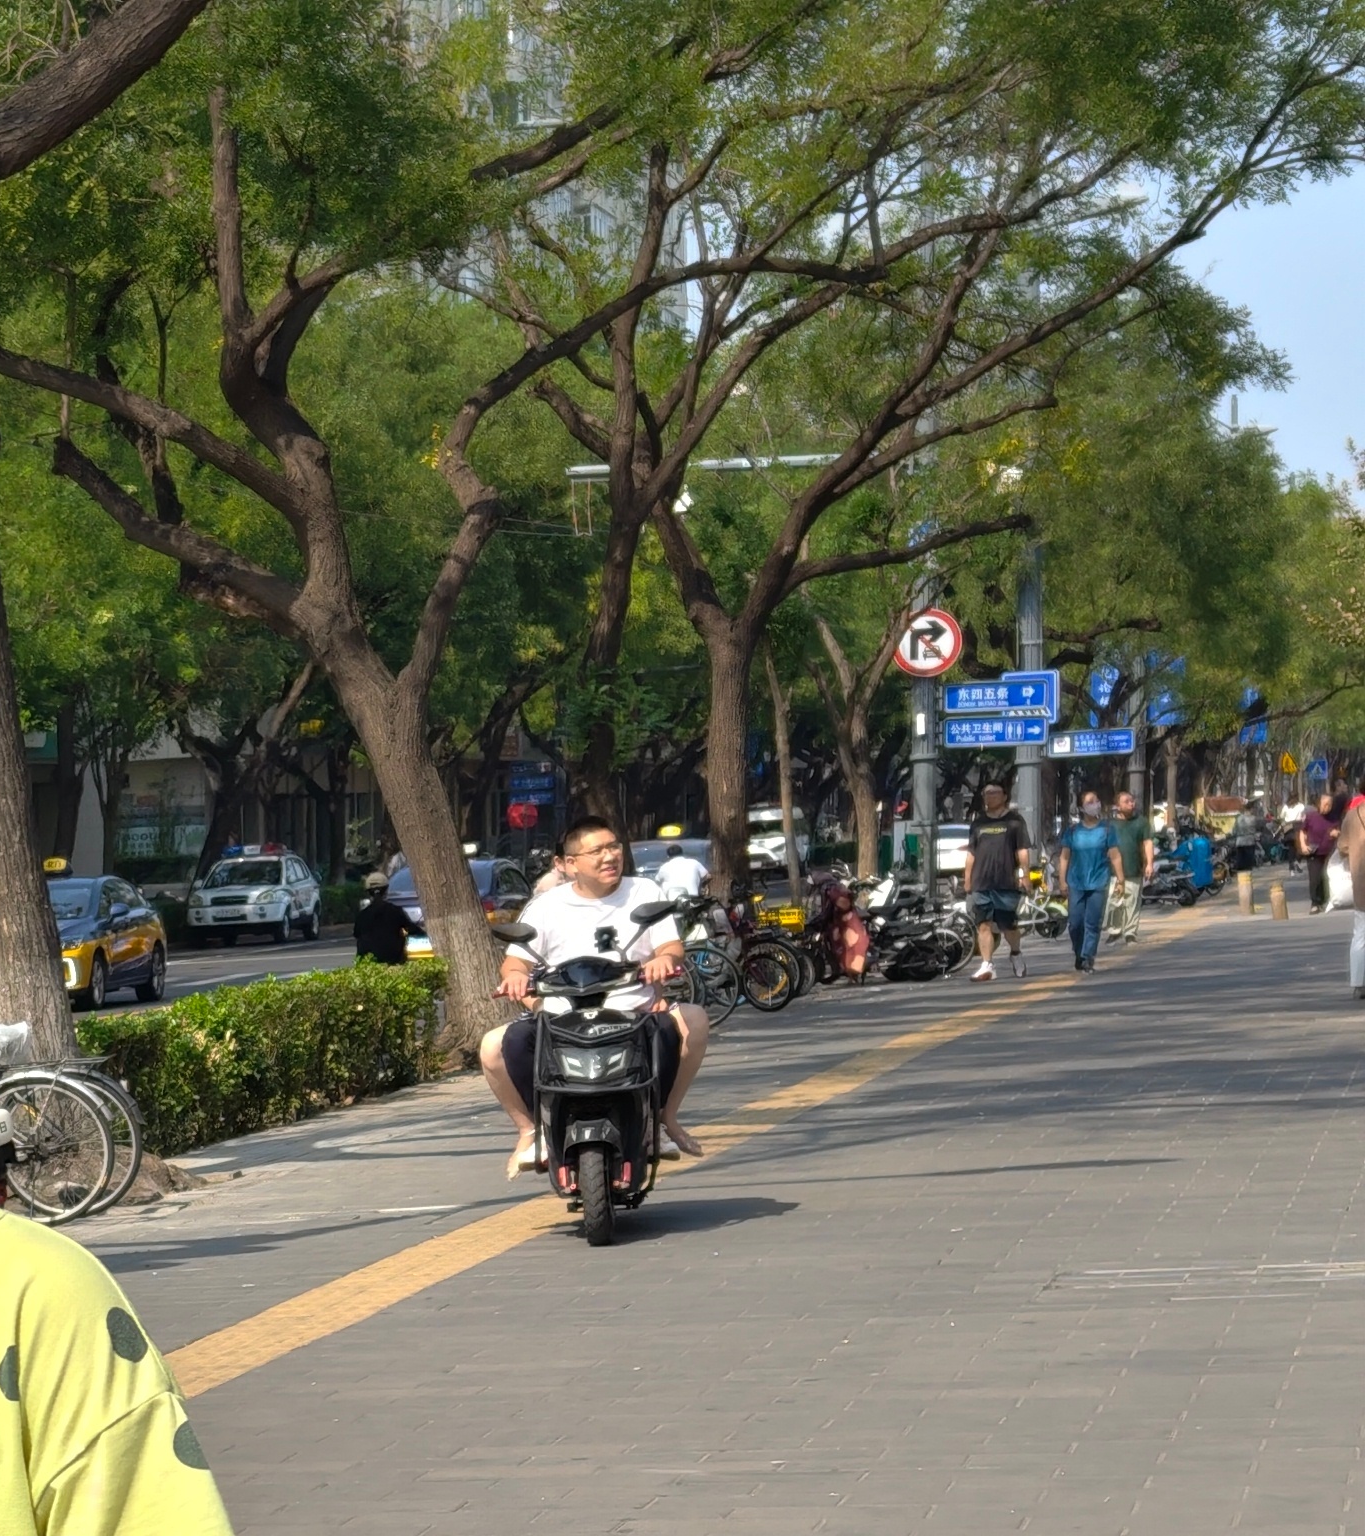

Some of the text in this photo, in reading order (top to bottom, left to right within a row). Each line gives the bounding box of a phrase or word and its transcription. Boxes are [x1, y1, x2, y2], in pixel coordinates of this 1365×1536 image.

[958, 686, 1009, 701] 东四五条
[950, 722, 1004, 734] 公共卫生间
